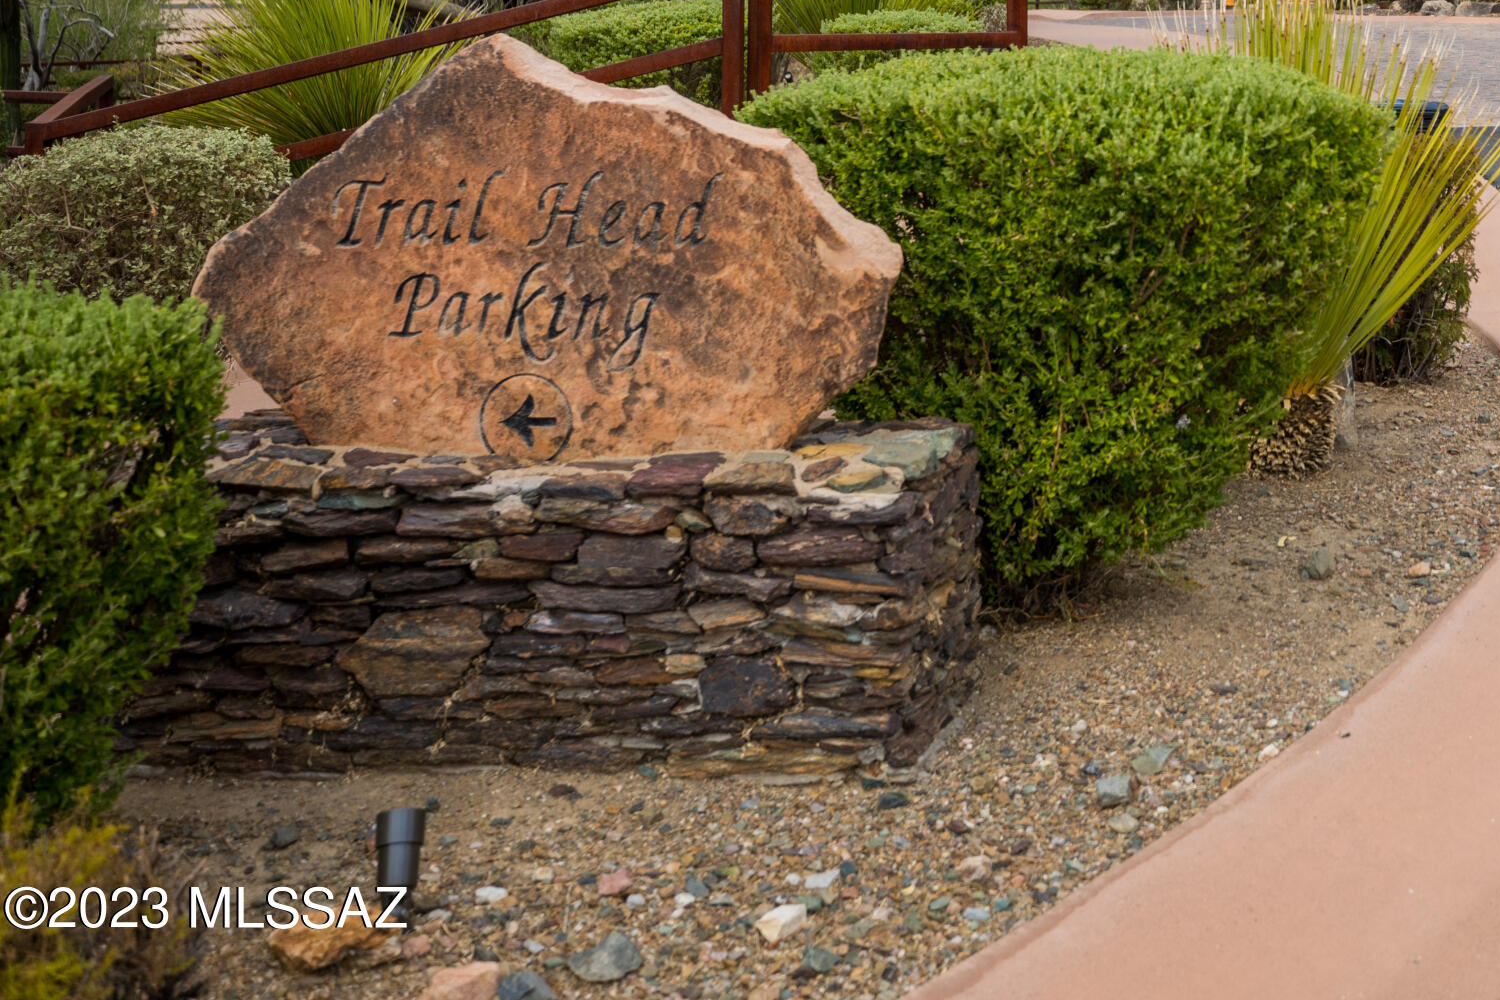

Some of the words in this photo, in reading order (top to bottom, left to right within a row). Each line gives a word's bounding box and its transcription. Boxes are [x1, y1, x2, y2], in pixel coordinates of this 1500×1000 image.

[331, 170, 504, 249] Trail
[527, 171, 725, 249] Head
[388, 261, 661, 373] Parking
